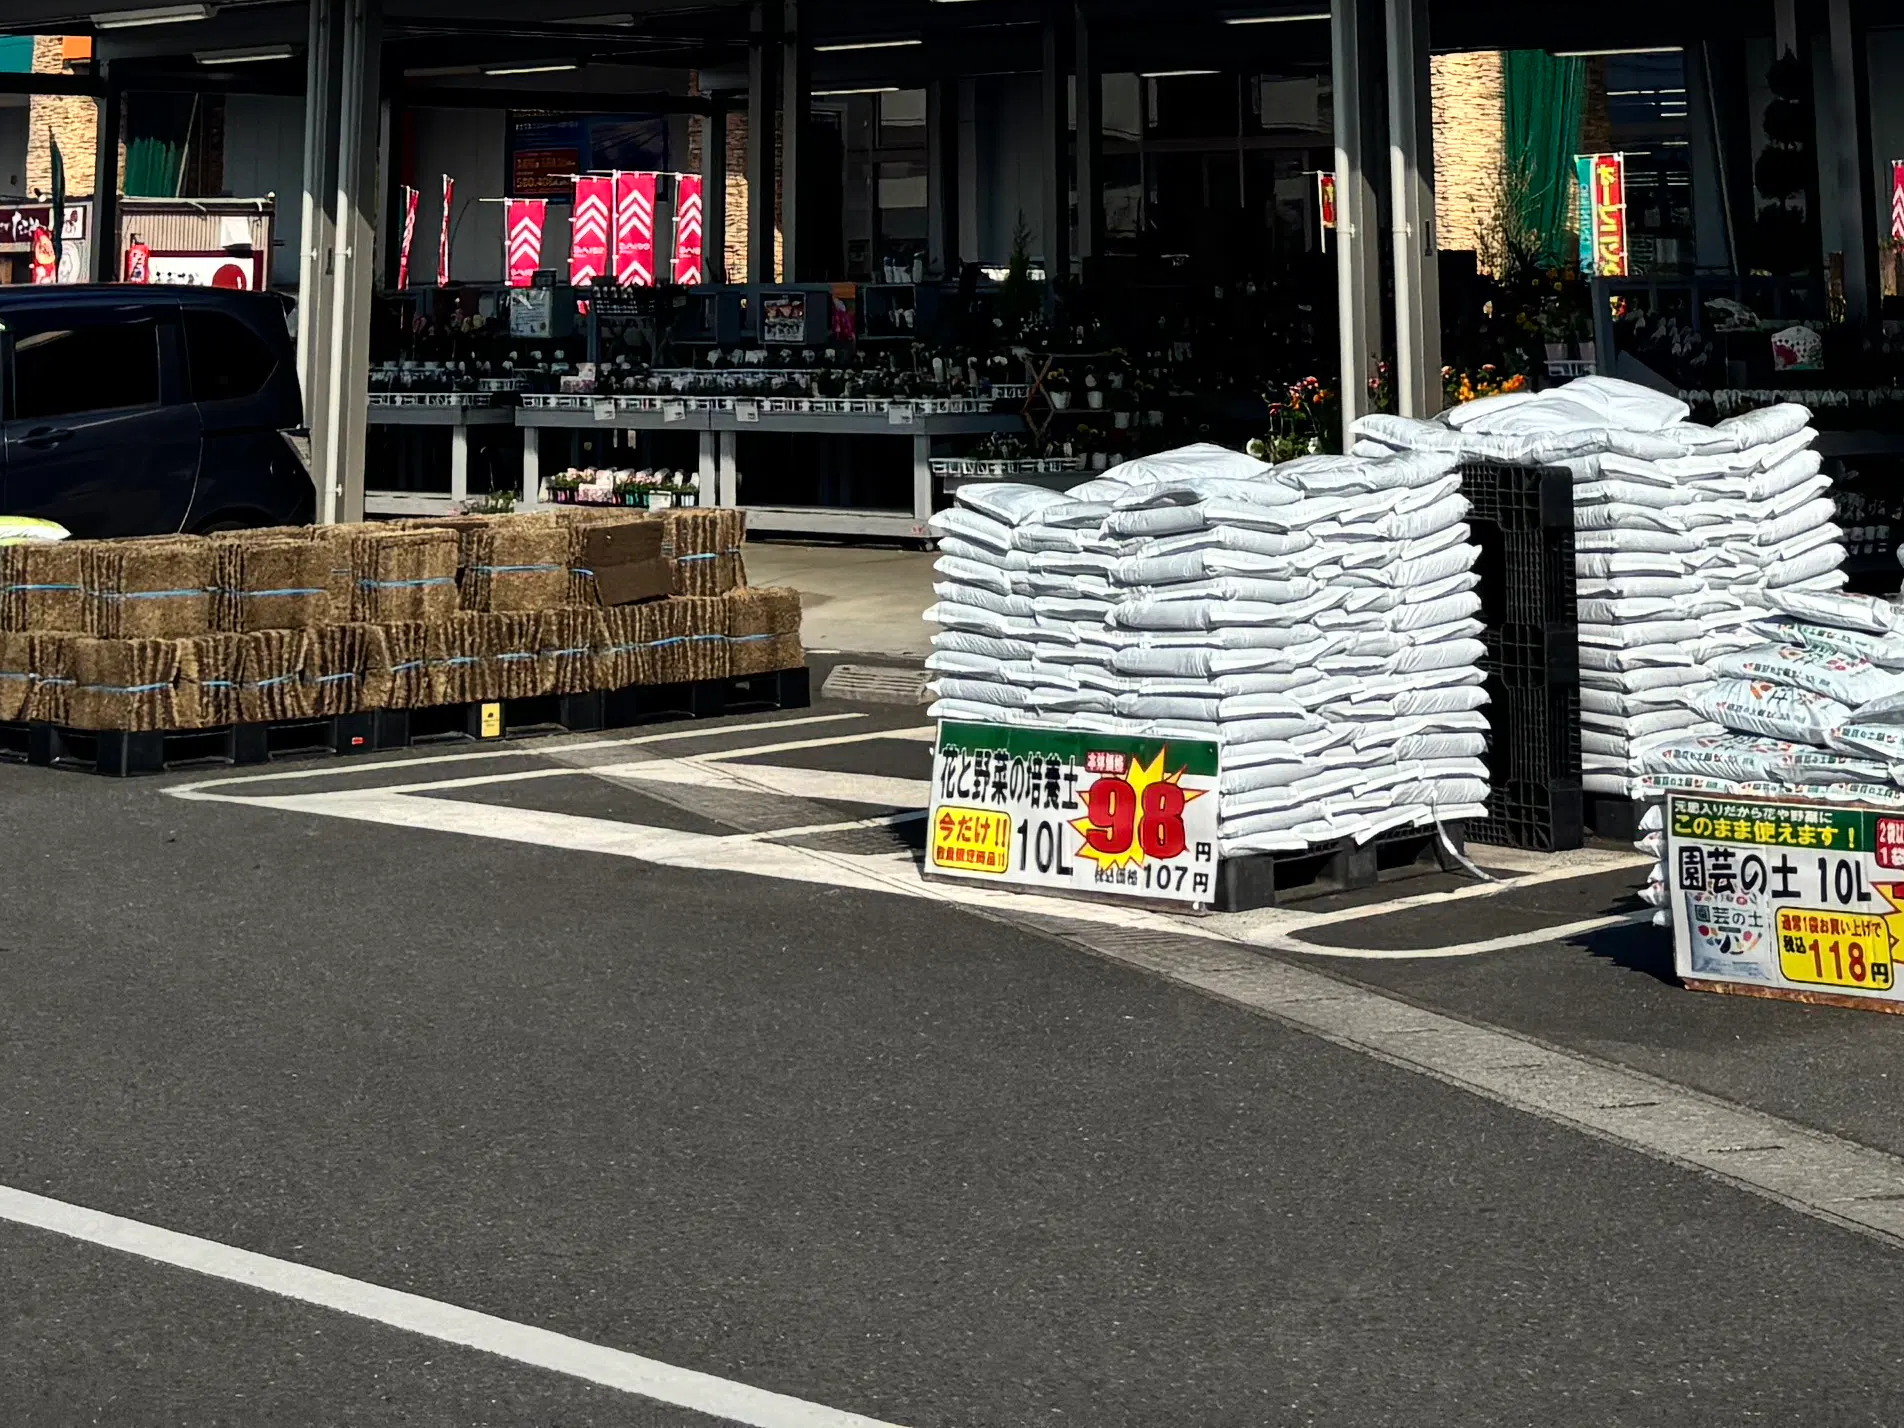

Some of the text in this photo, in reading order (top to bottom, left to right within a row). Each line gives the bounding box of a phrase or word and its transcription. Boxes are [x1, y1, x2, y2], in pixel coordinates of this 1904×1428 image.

[940, 744, 1079, 810] 花と野菜の培養土
[1017, 818, 1074, 876] 10L
[1086, 777, 1186, 859] 98
[1679, 846, 1872, 906] 園芸の土 10L
[1695, 905, 1764, 928] 園芸の土
